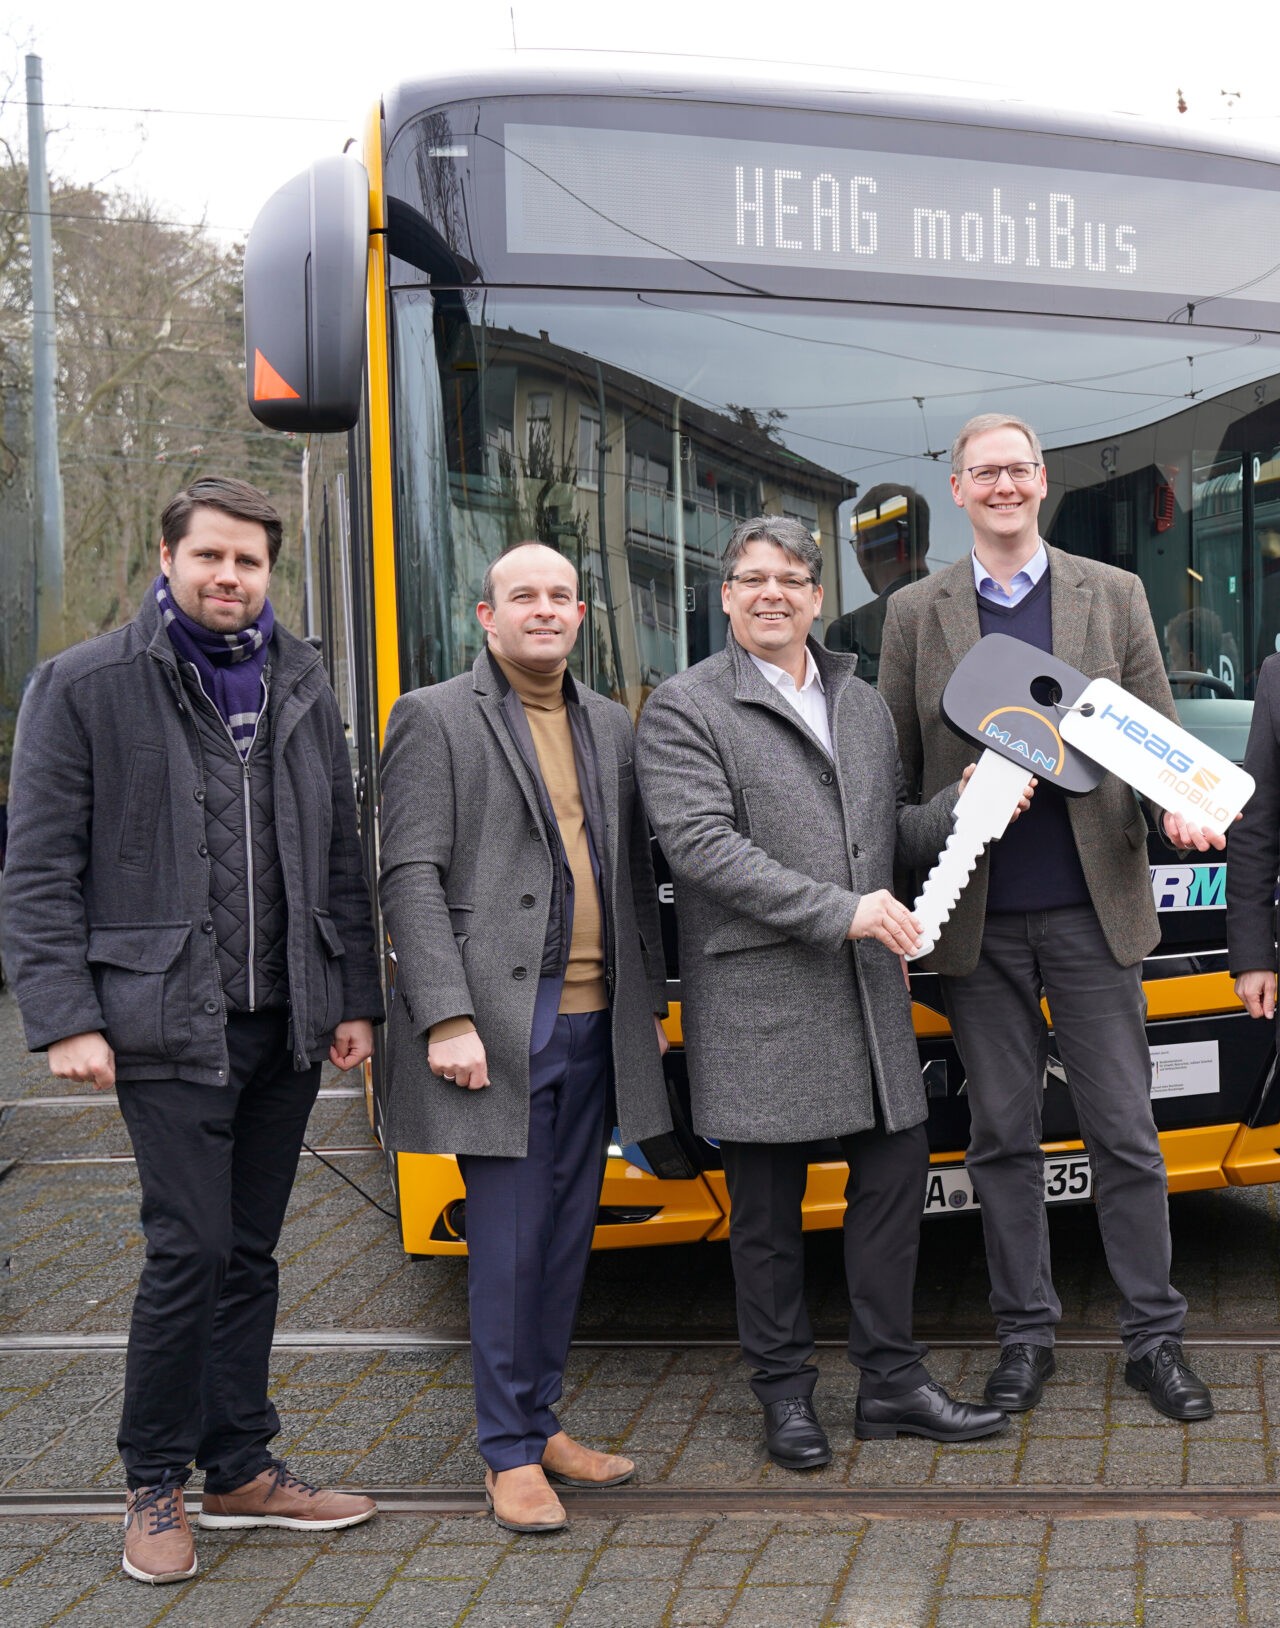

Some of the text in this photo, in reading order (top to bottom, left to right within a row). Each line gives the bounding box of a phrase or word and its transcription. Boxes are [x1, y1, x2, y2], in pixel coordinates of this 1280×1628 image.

[735, 165, 1138, 275] HEAG mobiBus
[985, 722, 1057, 773] MAN
